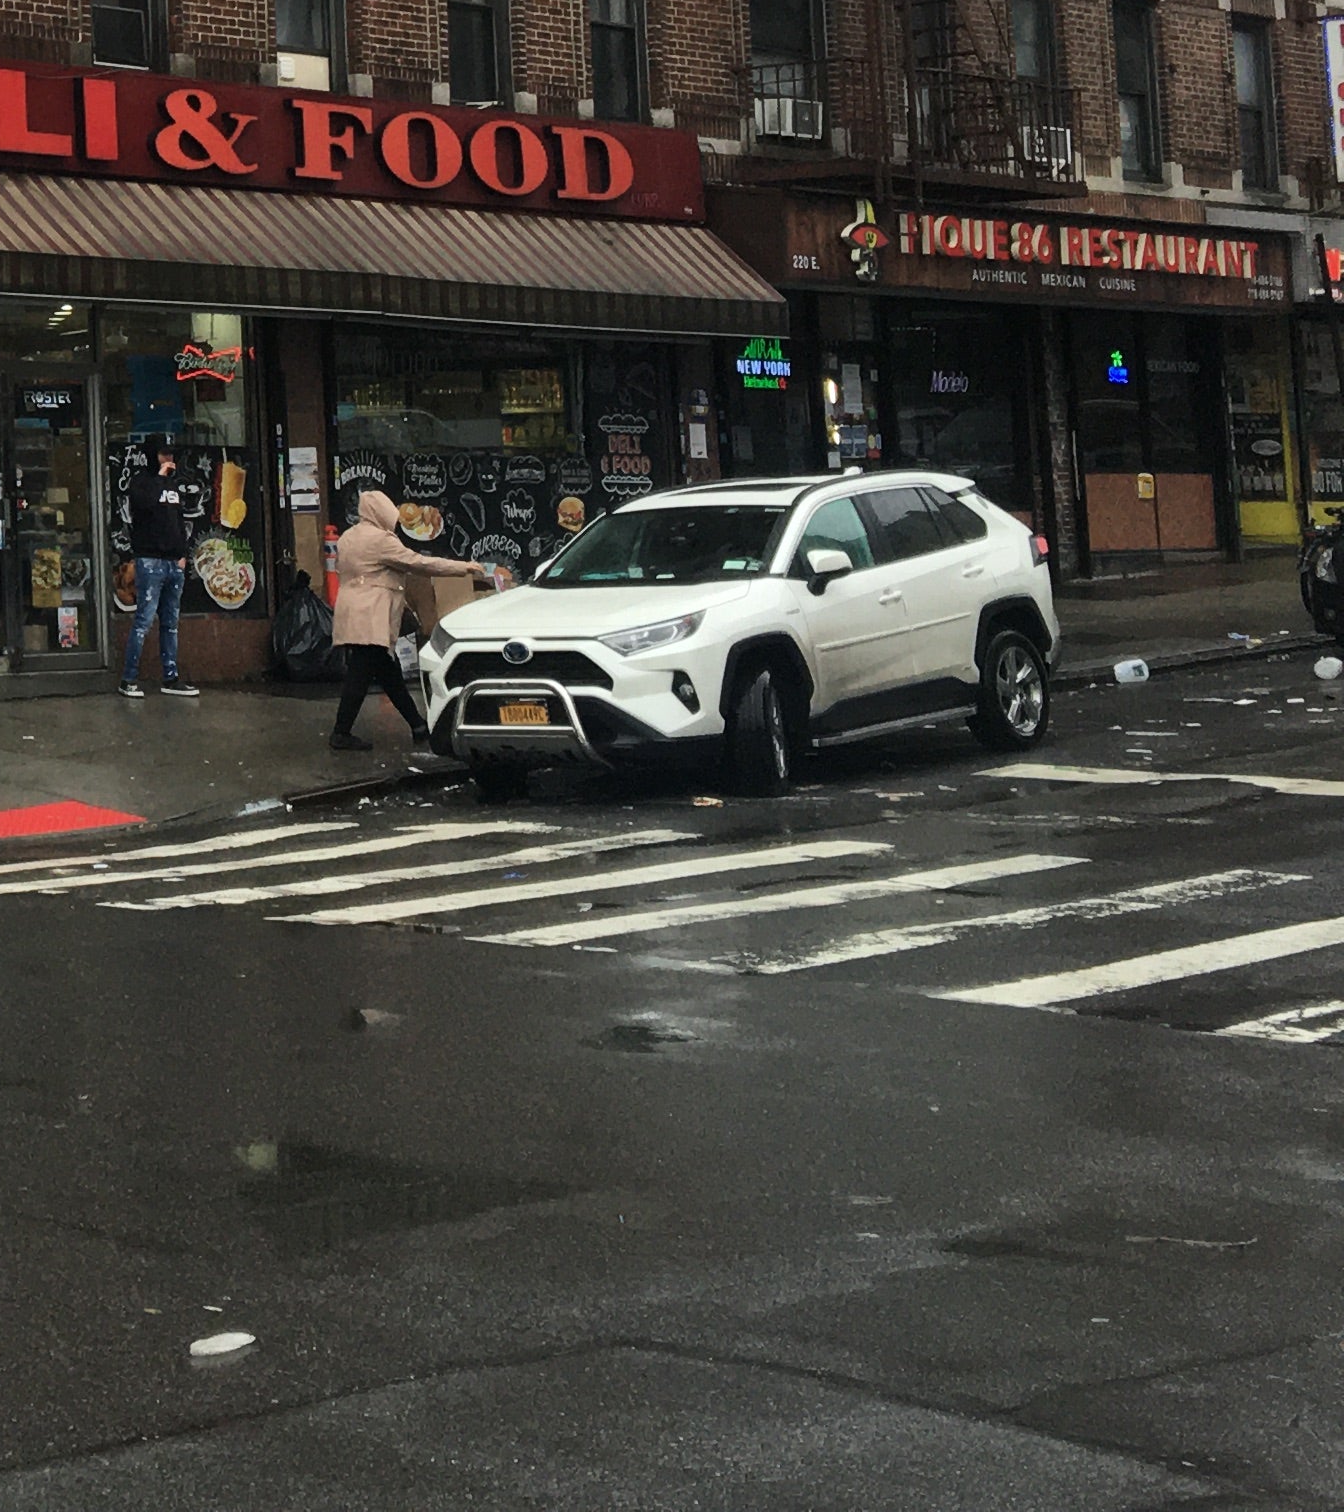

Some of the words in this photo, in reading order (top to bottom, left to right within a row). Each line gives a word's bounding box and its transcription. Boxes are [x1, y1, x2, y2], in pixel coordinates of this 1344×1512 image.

[154, 88, 259, 175] &
[294, 100, 637, 202] FOOD
[1011, 221, 1053, 265] 86
[1060, 227, 1259, 279] RESTAURANT
[792, 254, 810, 270] 220
[972, 268, 1028, 285] AUTHENTIC
[1041, 272, 1087, 289] MEXICAN
[1098, 276, 1137, 292] CUISINE
[736, 359, 762, 374] NEW
[763, 360, 791, 376] YORK
[930, 371, 969, 393] Modelo
[341, 464, 387, 486] BREAKFAST
[612, 455, 651, 475] FOOD
[471, 534, 522, 562] BURGERS
